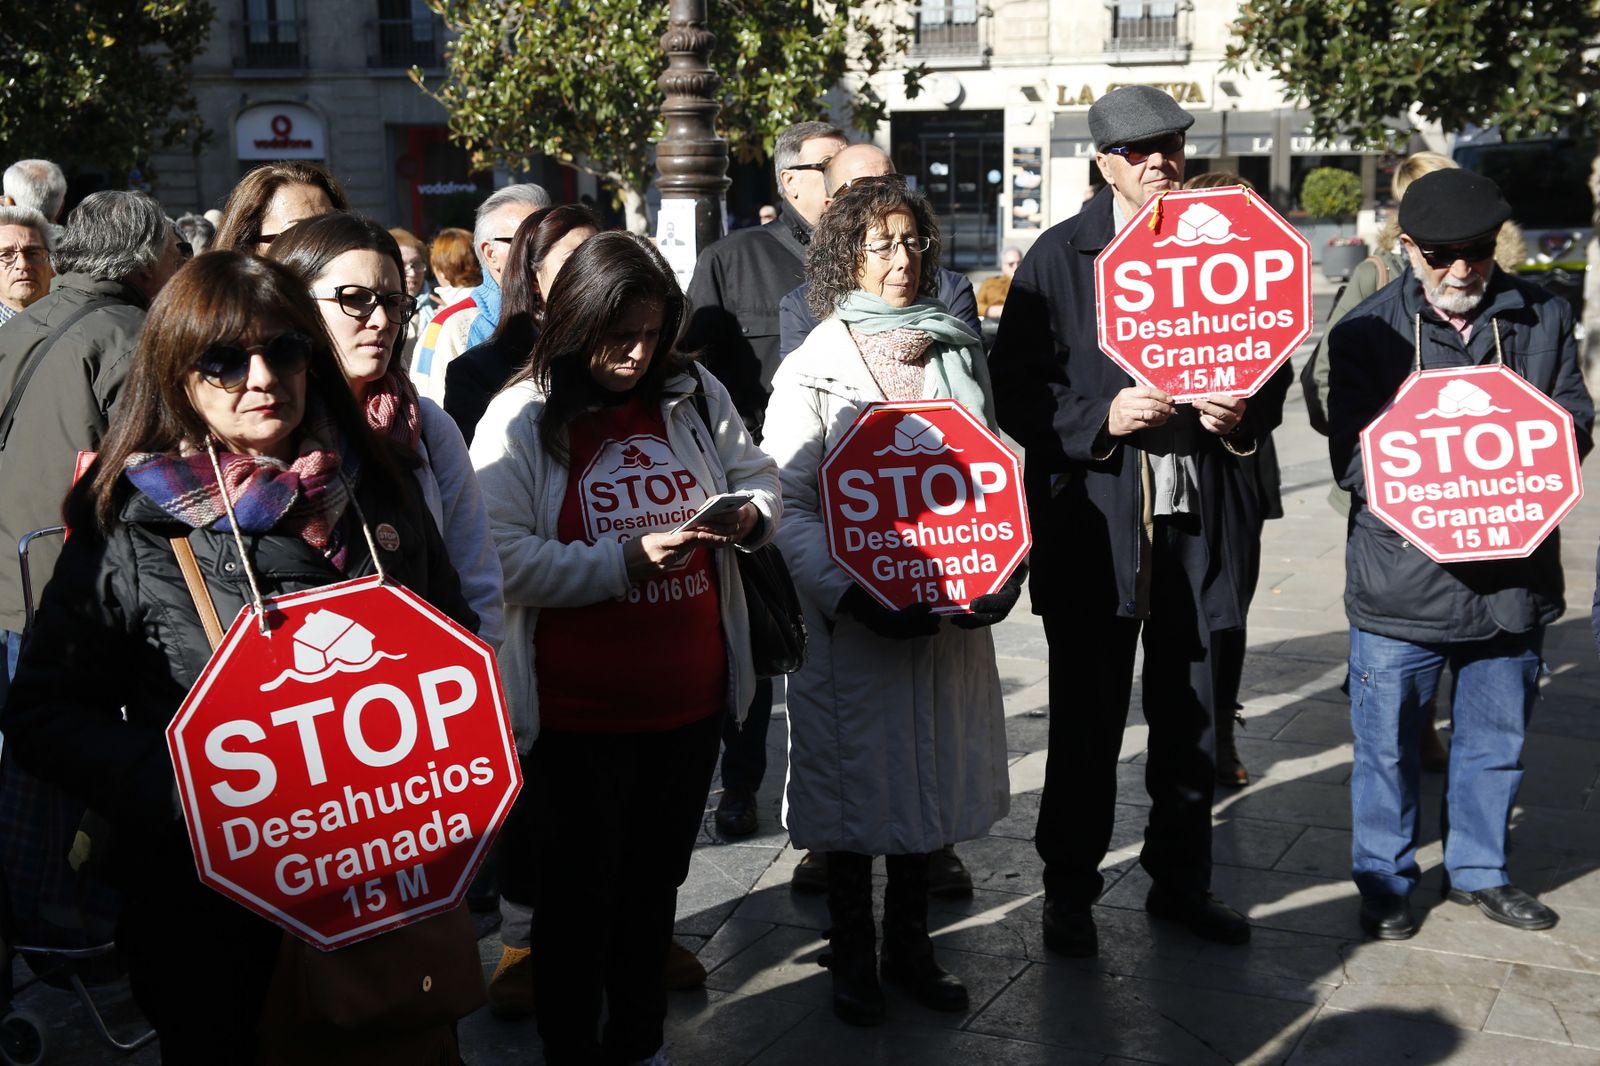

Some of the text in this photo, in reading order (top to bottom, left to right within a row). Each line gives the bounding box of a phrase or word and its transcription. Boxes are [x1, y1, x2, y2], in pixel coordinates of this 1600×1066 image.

[1056, 84, 1096, 106] LA
[254, 136, 313, 149] vodafone
[1113, 249, 1295, 312] STOP
[1116, 306, 1294, 342] Desahucios
[1141, 336, 1271, 369] Granada
[1179, 365, 1236, 390] 15 M
[1378, 419, 1558, 478] STOP
[589, 469, 697, 513] STOP
[837, 461, 1008, 522] STOP
[1384, 471, 1564, 504] Desahucios
[596, 506, 697, 533] Desahucio
[1411, 498, 1544, 530] Granada
[844, 518, 1014, 552] Desahucios
[1451, 526, 1511, 549] 15 M
[872, 548, 998, 581] Granada
[646, 577, 683, 604] 016
[684, 569, 709, 598] 025
[911, 579, 967, 603] 15 M
[204, 664, 478, 807] STOP
[221, 756, 495, 861] Desahucios
[274, 809, 474, 896] Granada
[342, 863, 431, 918] 15 M
